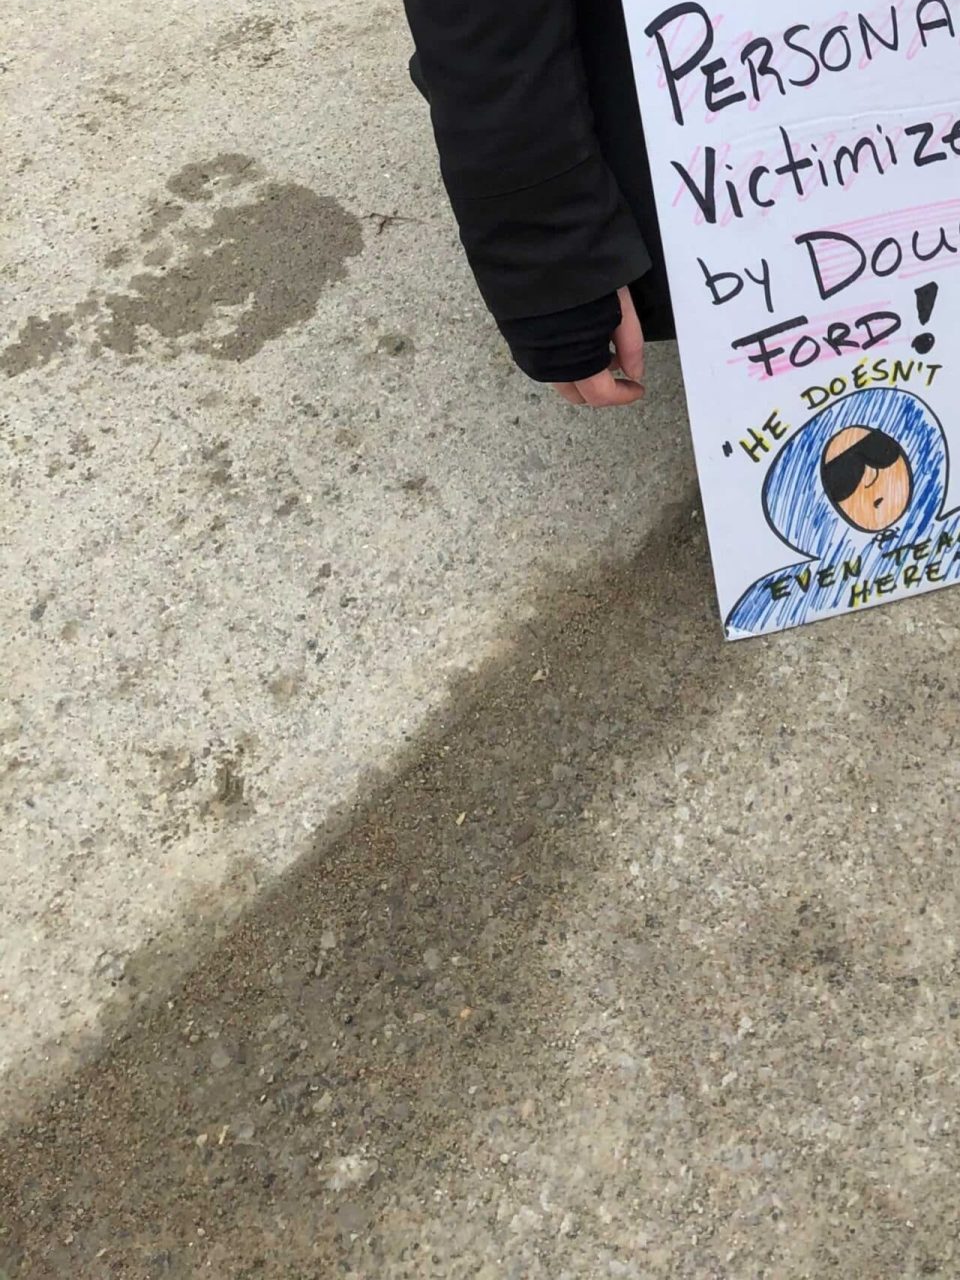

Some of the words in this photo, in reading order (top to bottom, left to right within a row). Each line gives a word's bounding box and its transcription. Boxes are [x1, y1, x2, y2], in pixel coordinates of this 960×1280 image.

[699, 258, 771, 313] by
[733, 282, 939, 376] FORD!
[801, 358, 943, 410] DOESN'T
[768, 555, 862, 601] EVEN
